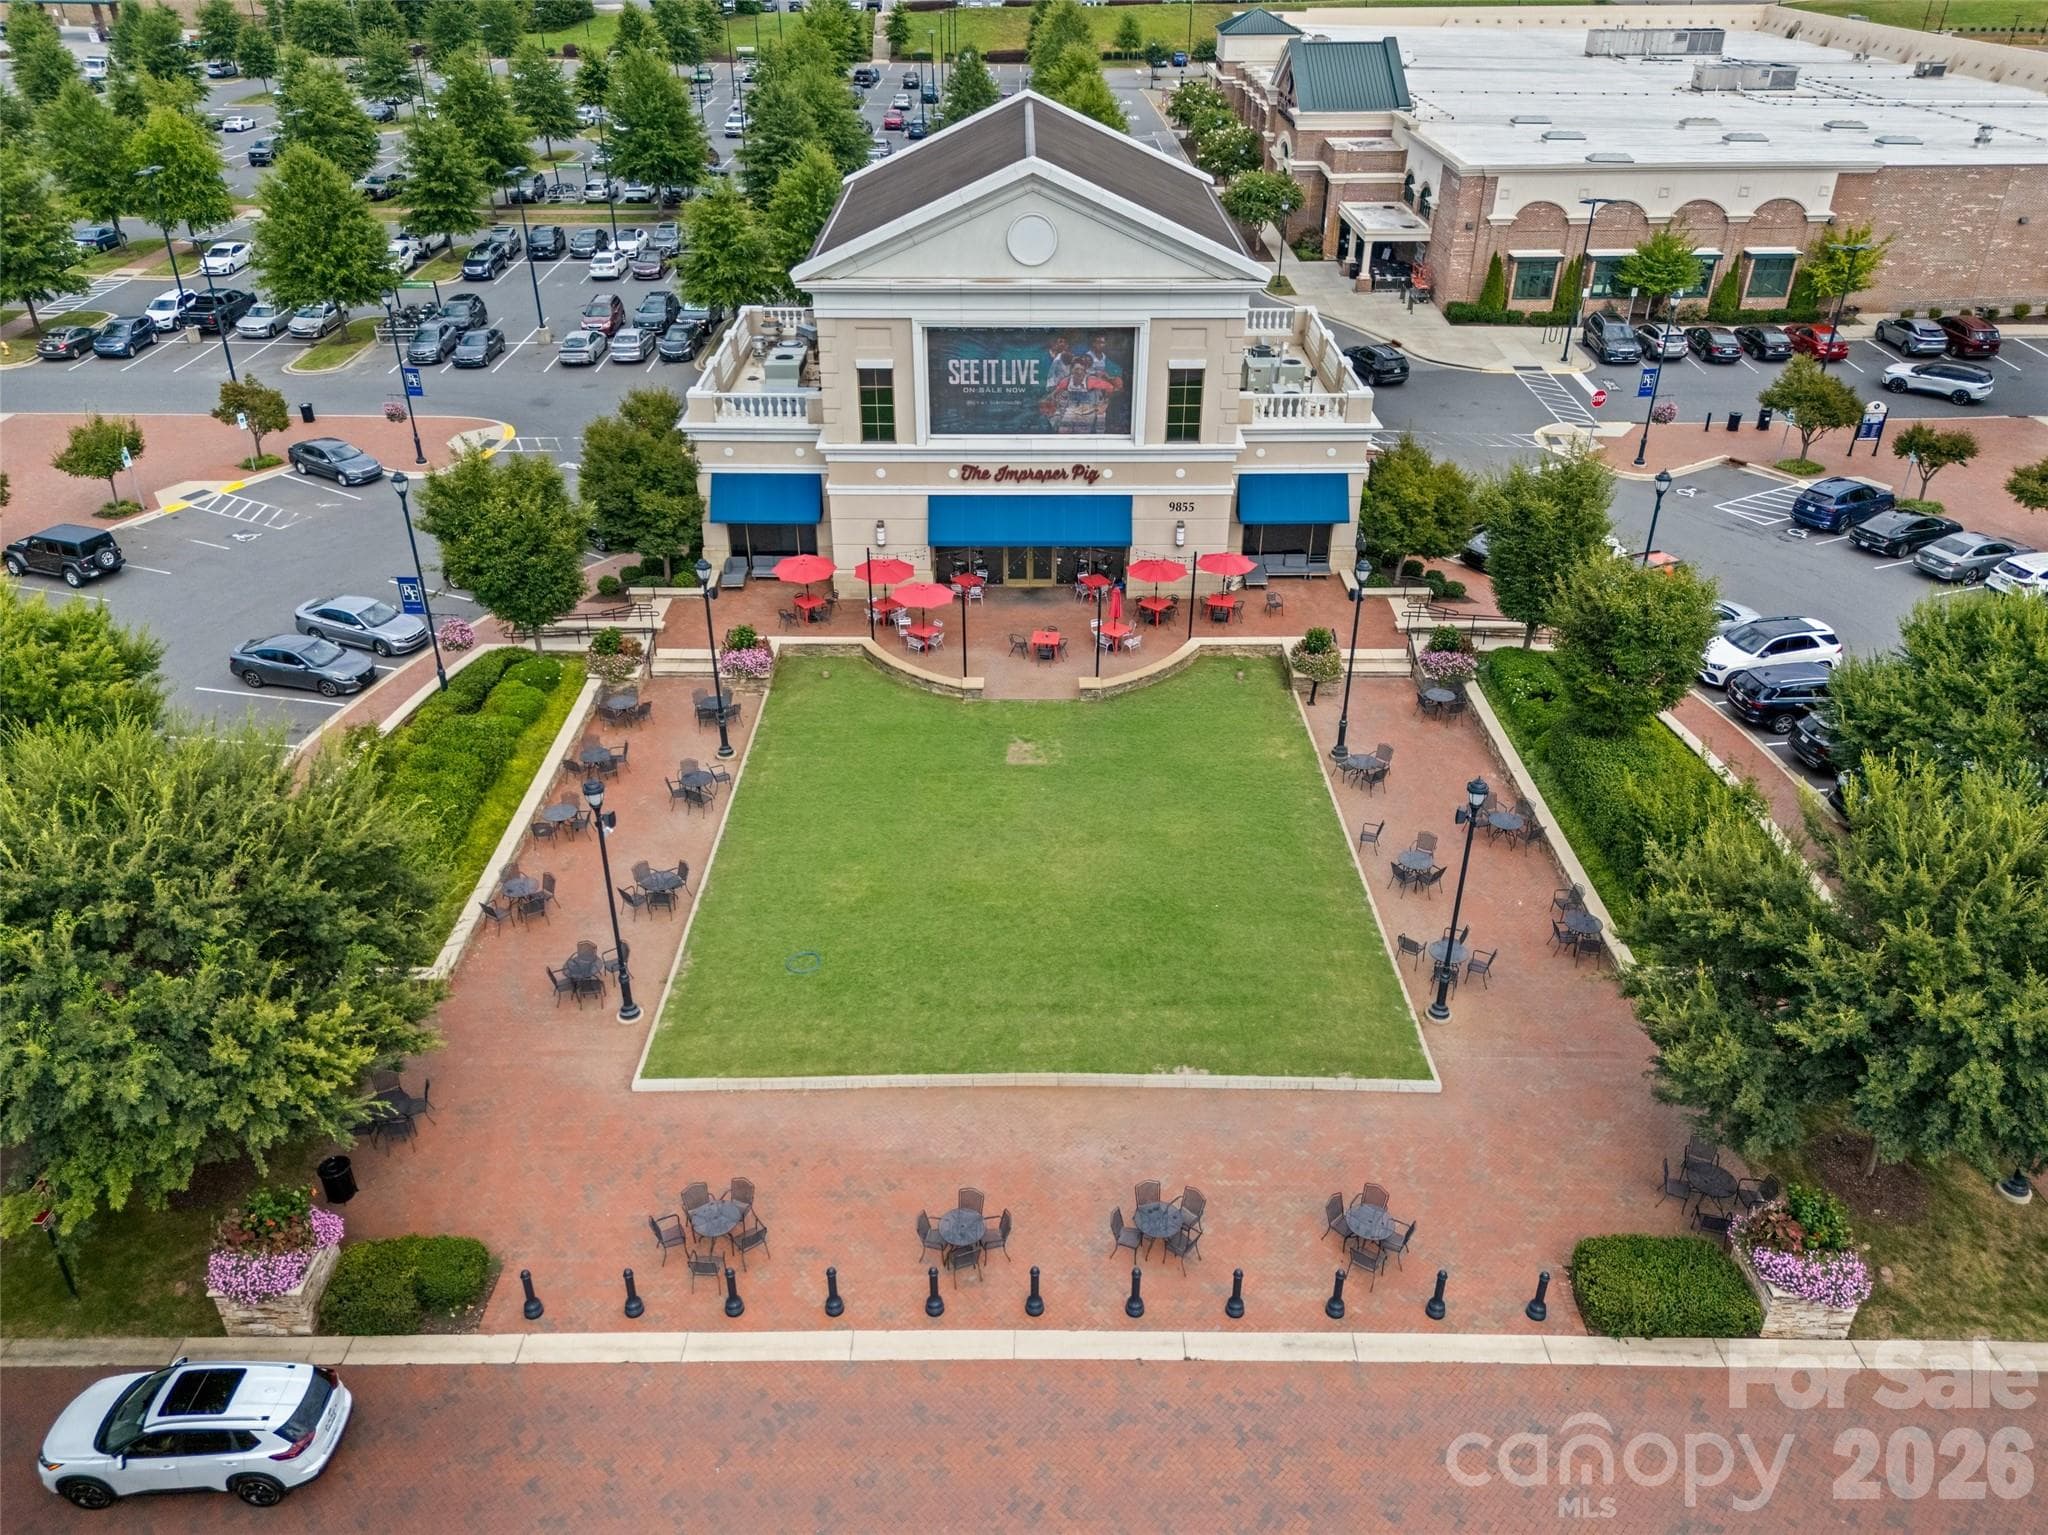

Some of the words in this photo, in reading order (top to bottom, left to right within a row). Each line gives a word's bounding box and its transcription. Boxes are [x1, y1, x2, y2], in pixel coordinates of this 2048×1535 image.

[948, 359, 980, 385] SEE
[982, 359, 999, 385] IT
[1001, 359, 1040, 385] LIVE
[961, 464, 991, 481] The
[994, 465, 1069, 484] Improper
[1071, 464, 1100, 485] Pig
[1169, 502, 1195, 512] 9855
